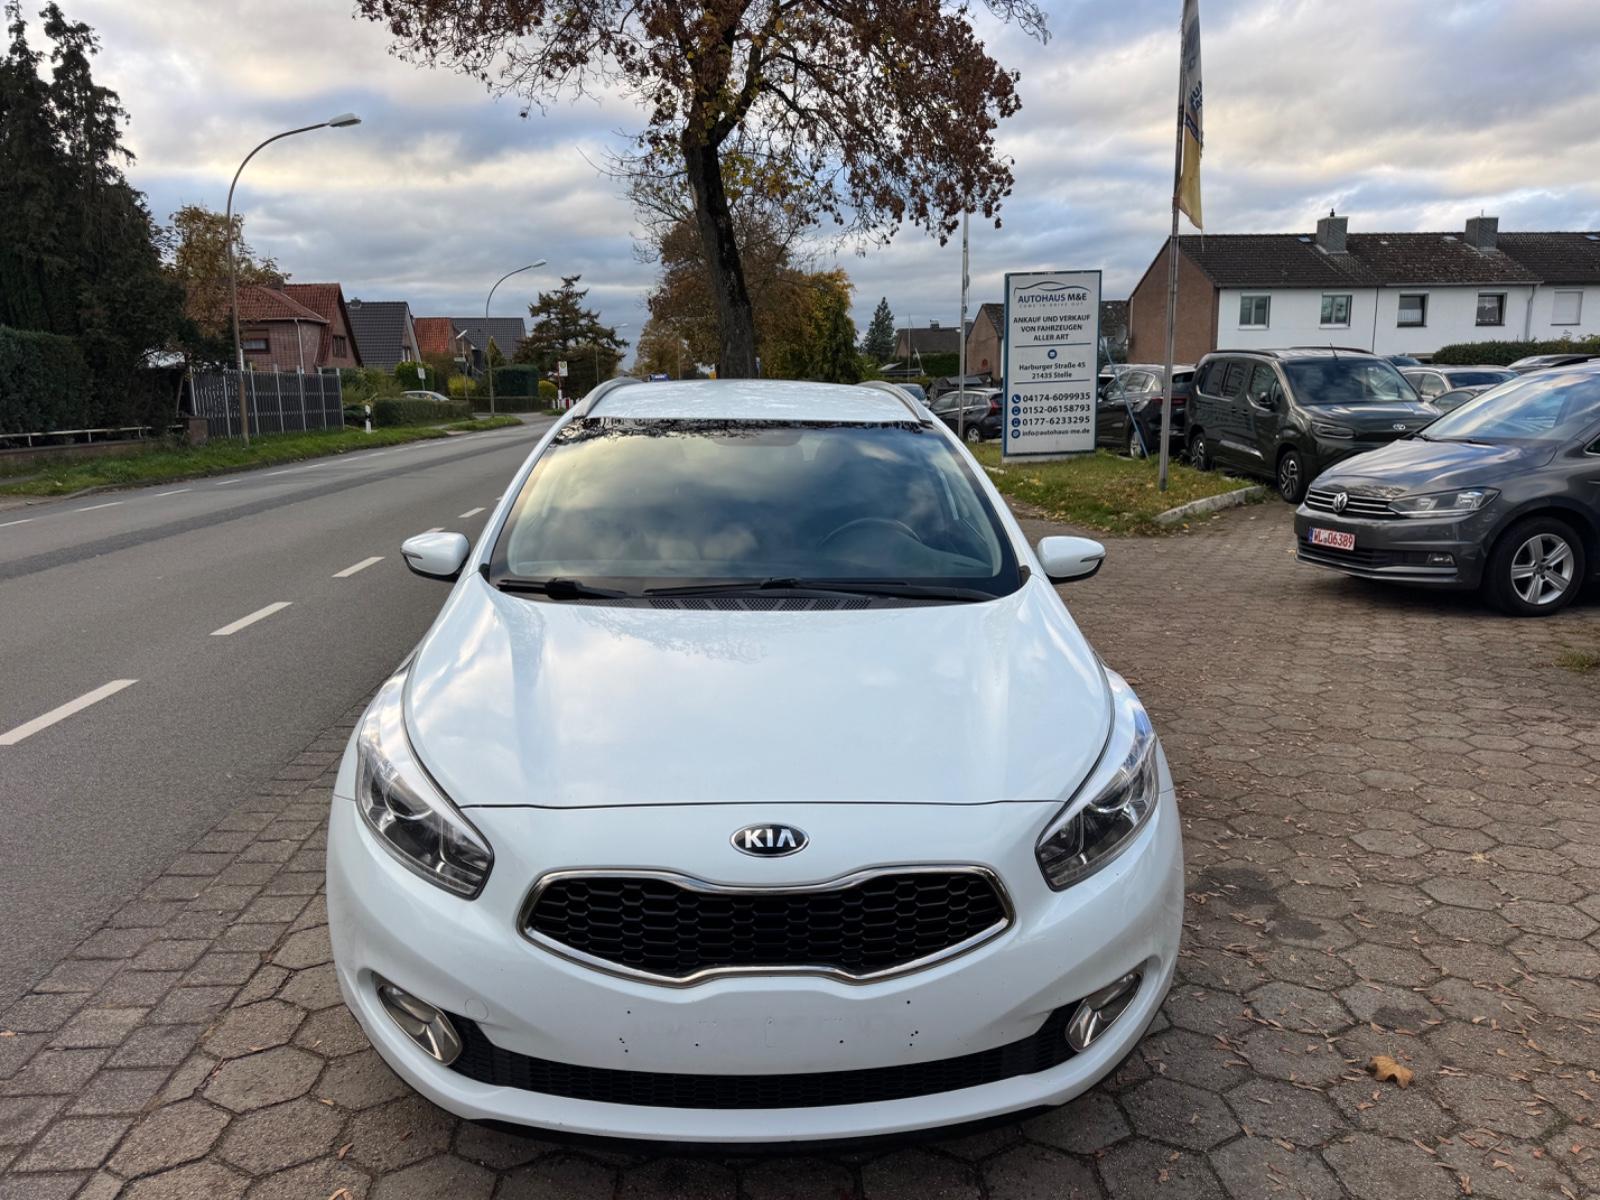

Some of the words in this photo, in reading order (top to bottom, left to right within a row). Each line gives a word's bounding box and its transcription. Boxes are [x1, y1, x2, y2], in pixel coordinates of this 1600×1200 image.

[1018, 293, 1066, 303] AUTOHAUS
[1068, 291, 1087, 301] M&E
[1037, 324, 1082, 332] FAHRZEUGEN
[1054, 362, 1076, 370] Straße
[1023, 392, 1090, 402] 04174-6099935
[1023, 404, 1090, 414] 0152-06158793
[1023, 416, 1090, 426] 0177-6233295
[744, 828, 797, 848] KIA
